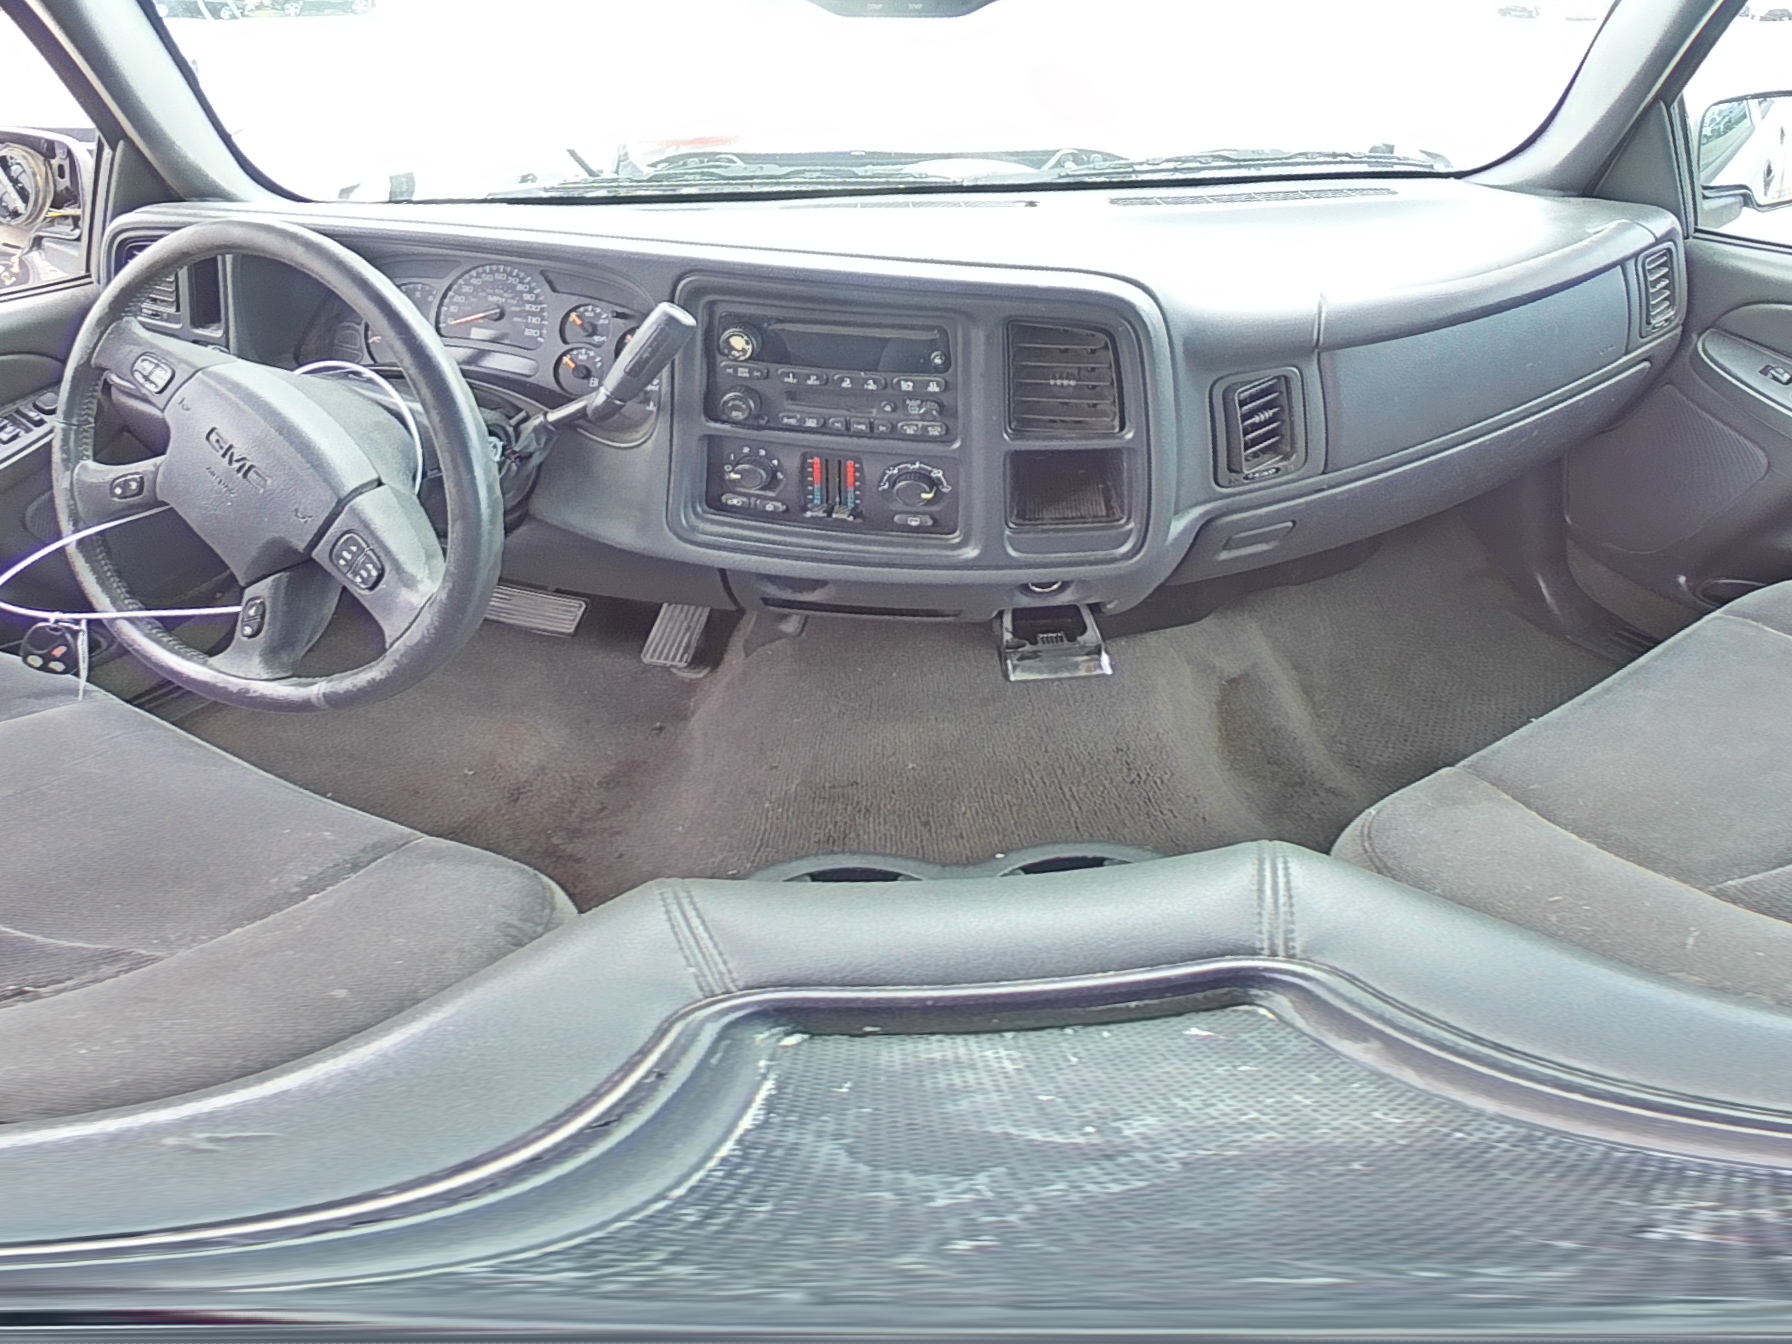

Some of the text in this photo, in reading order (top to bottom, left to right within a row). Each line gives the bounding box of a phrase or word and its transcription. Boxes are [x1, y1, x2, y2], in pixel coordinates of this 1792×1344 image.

[524, 303, 541, 312] 100
[527, 315, 541, 324] 110
[205, 426, 272, 494] GMC
